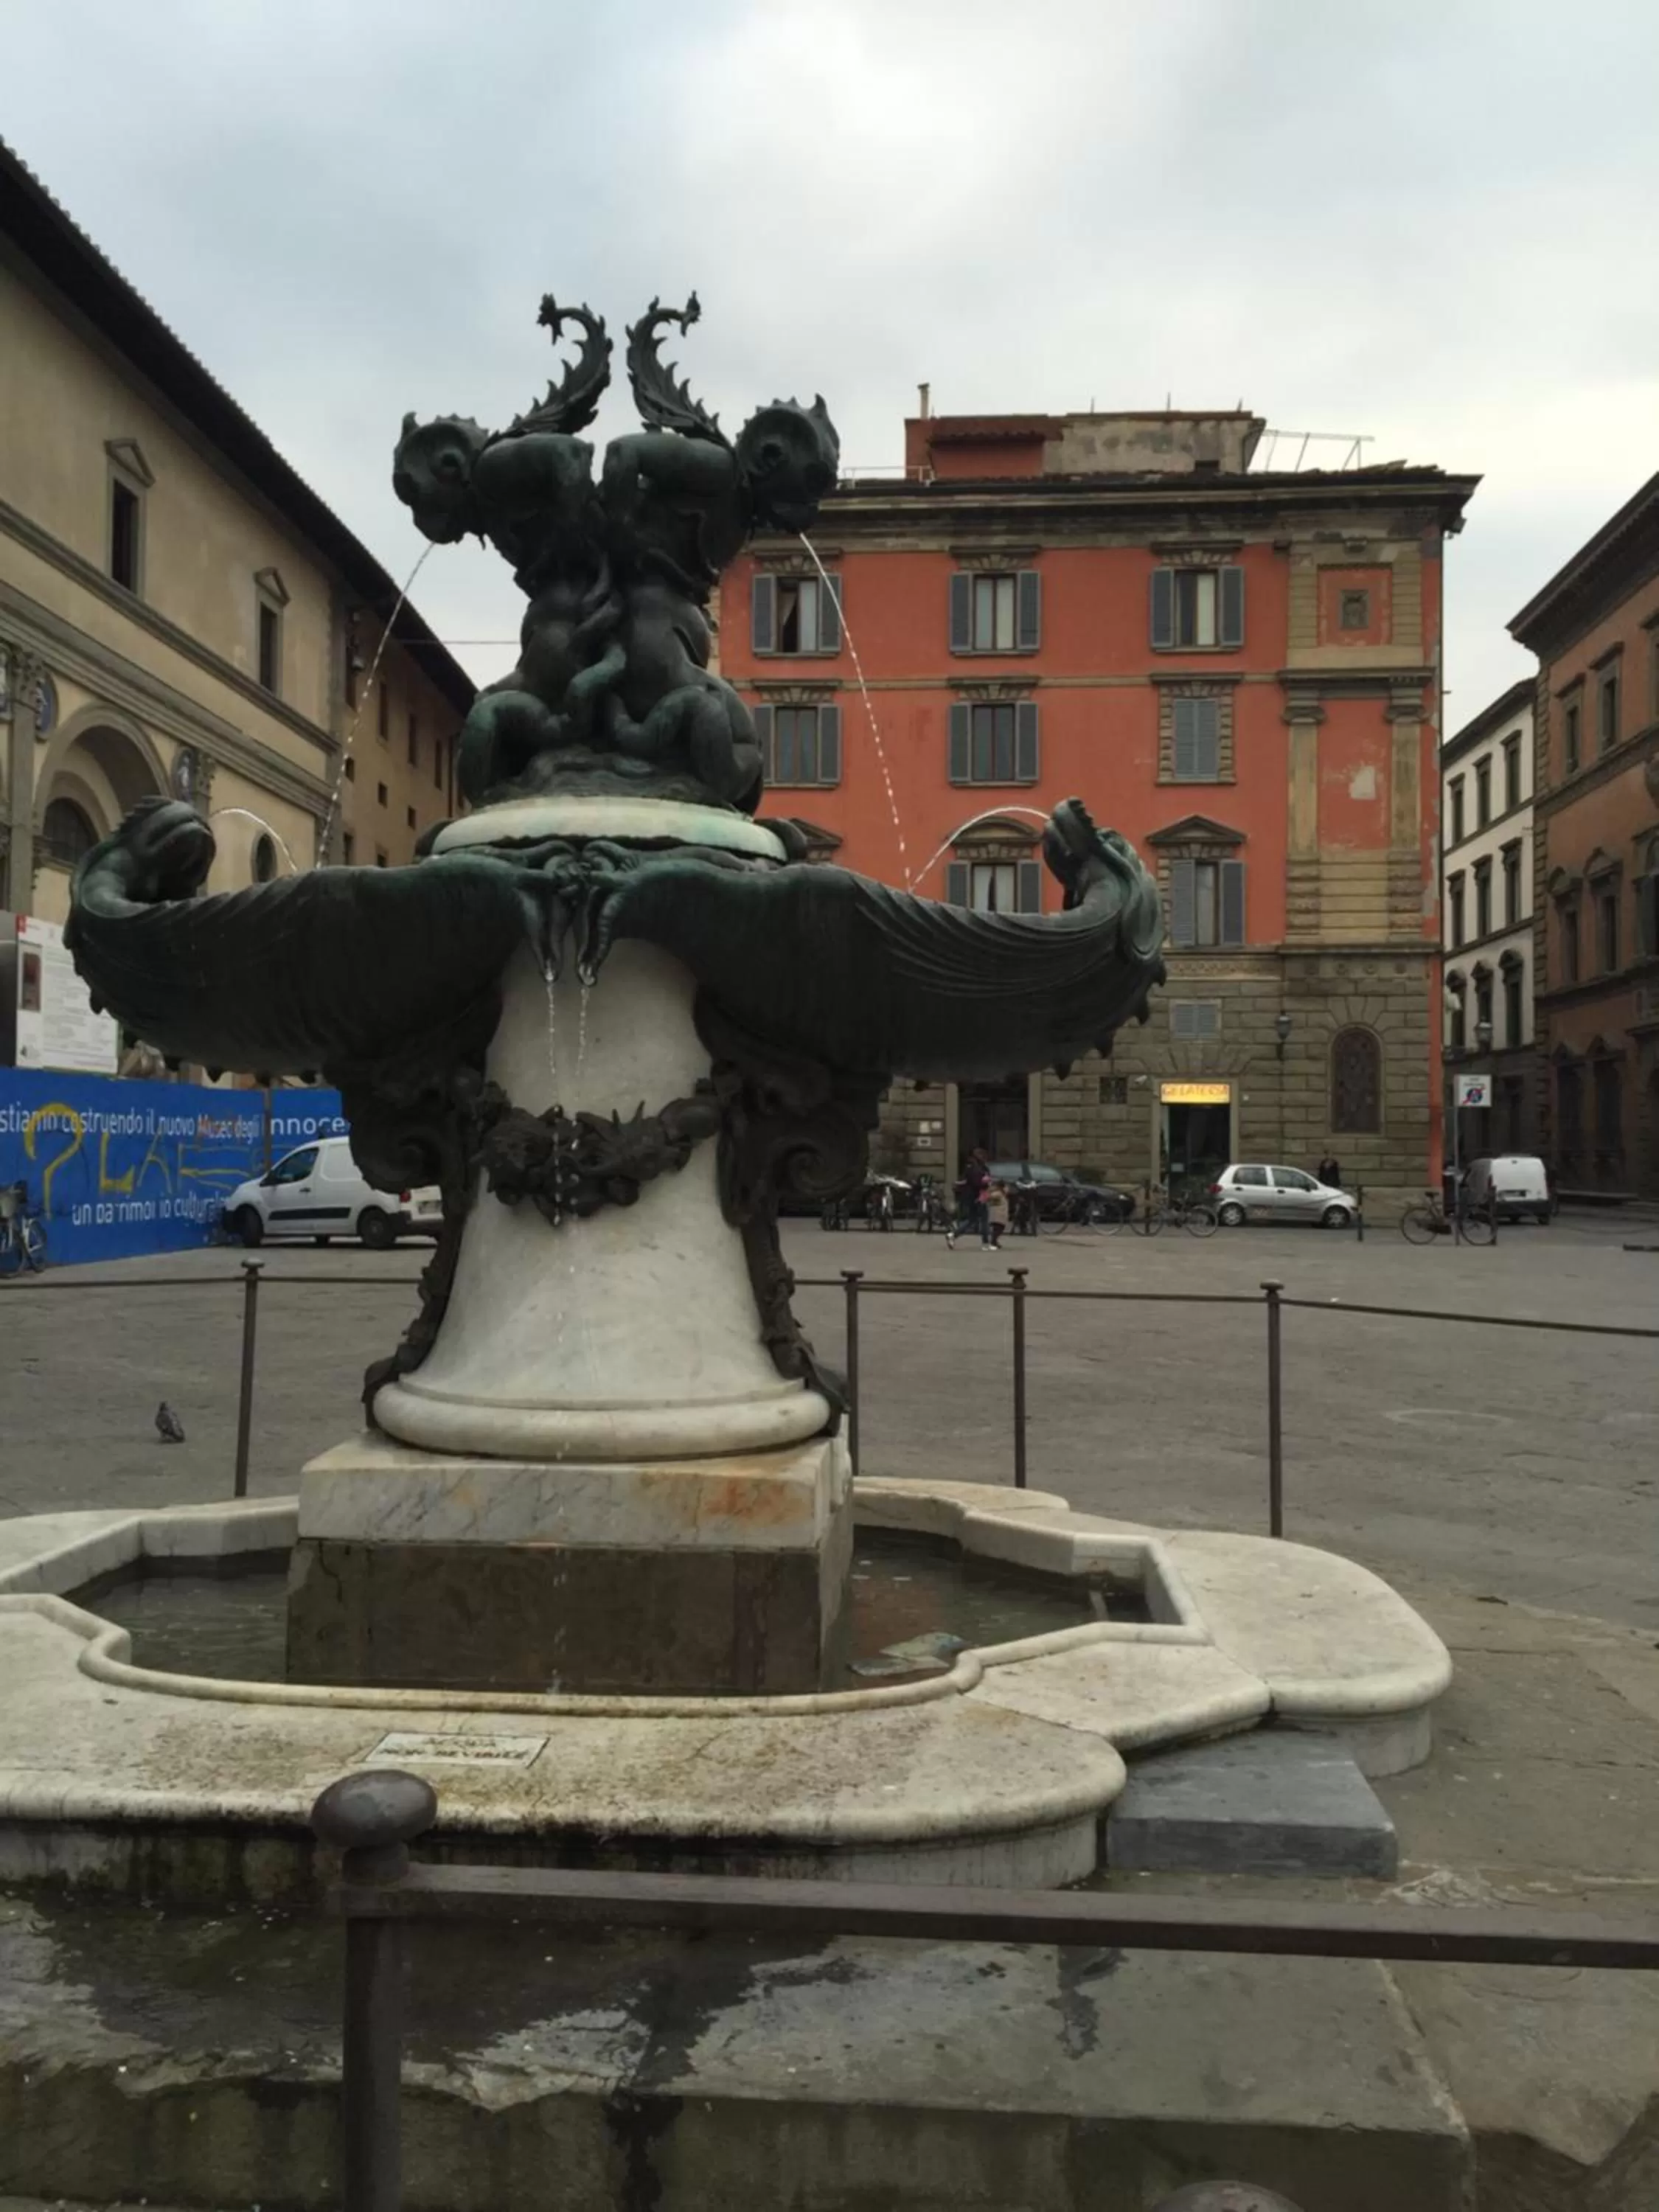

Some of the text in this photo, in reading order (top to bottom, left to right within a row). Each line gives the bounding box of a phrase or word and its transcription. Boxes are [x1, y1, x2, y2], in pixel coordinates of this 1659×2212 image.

[146, 1108, 156, 1135] il
[158, 1115, 195, 1136] nuovo
[72, 1202, 91, 1226] un
